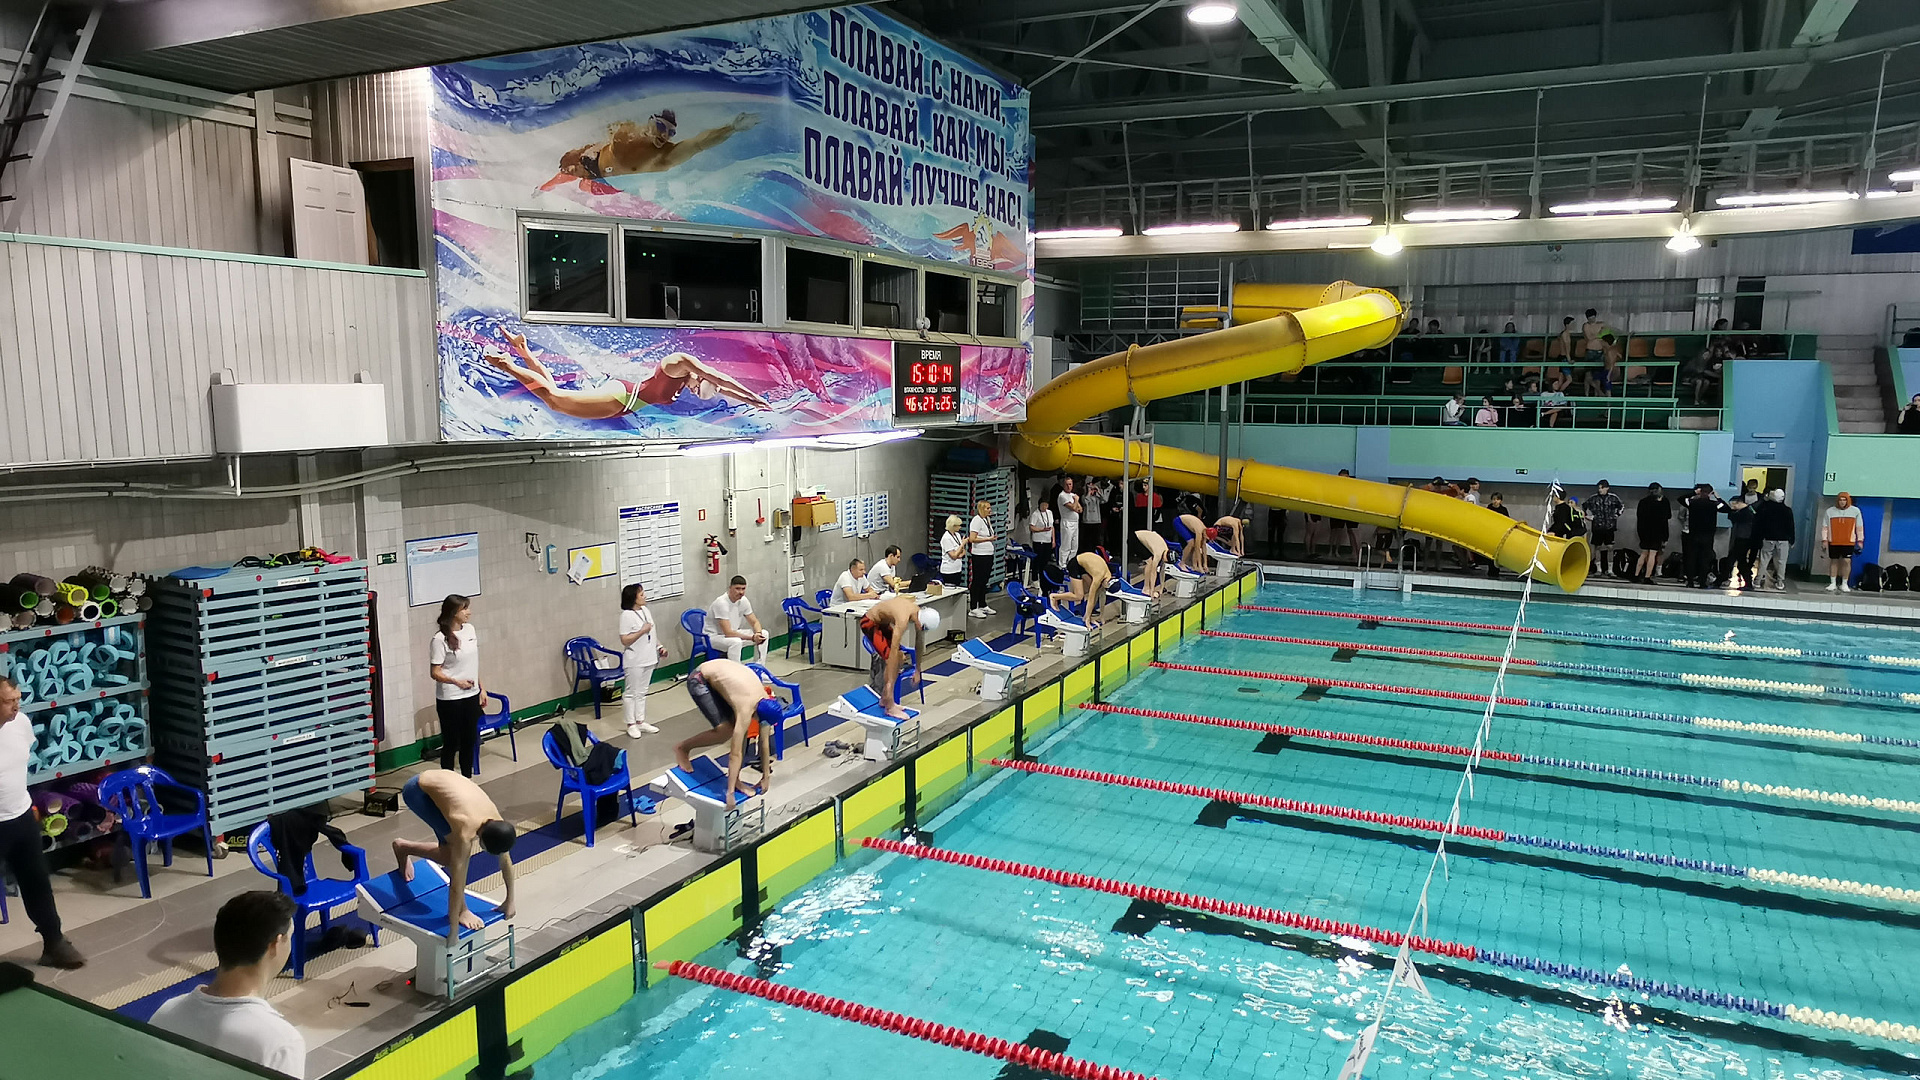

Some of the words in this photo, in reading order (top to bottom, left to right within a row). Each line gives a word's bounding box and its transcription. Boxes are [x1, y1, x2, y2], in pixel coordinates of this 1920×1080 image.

[829, 9, 924, 95] ПЛАВАЙ
[931, 60, 943, 100] С
[950, 67, 1006, 128] НАМИ,
[804, 126, 903, 206] ПЛАВАЙ
[911, 162, 980, 212] ЛУЧШЕ
[985, 184, 1022, 230] НАС!
[823, 70, 926, 153] ПЛАВАЙ,
[932, 112, 970, 163] КАК
[975, 125, 1012, 182] МЫ,
[921, 350, 941, 360] ВРЕМЯ
[459, 939, 473, 973] 1
